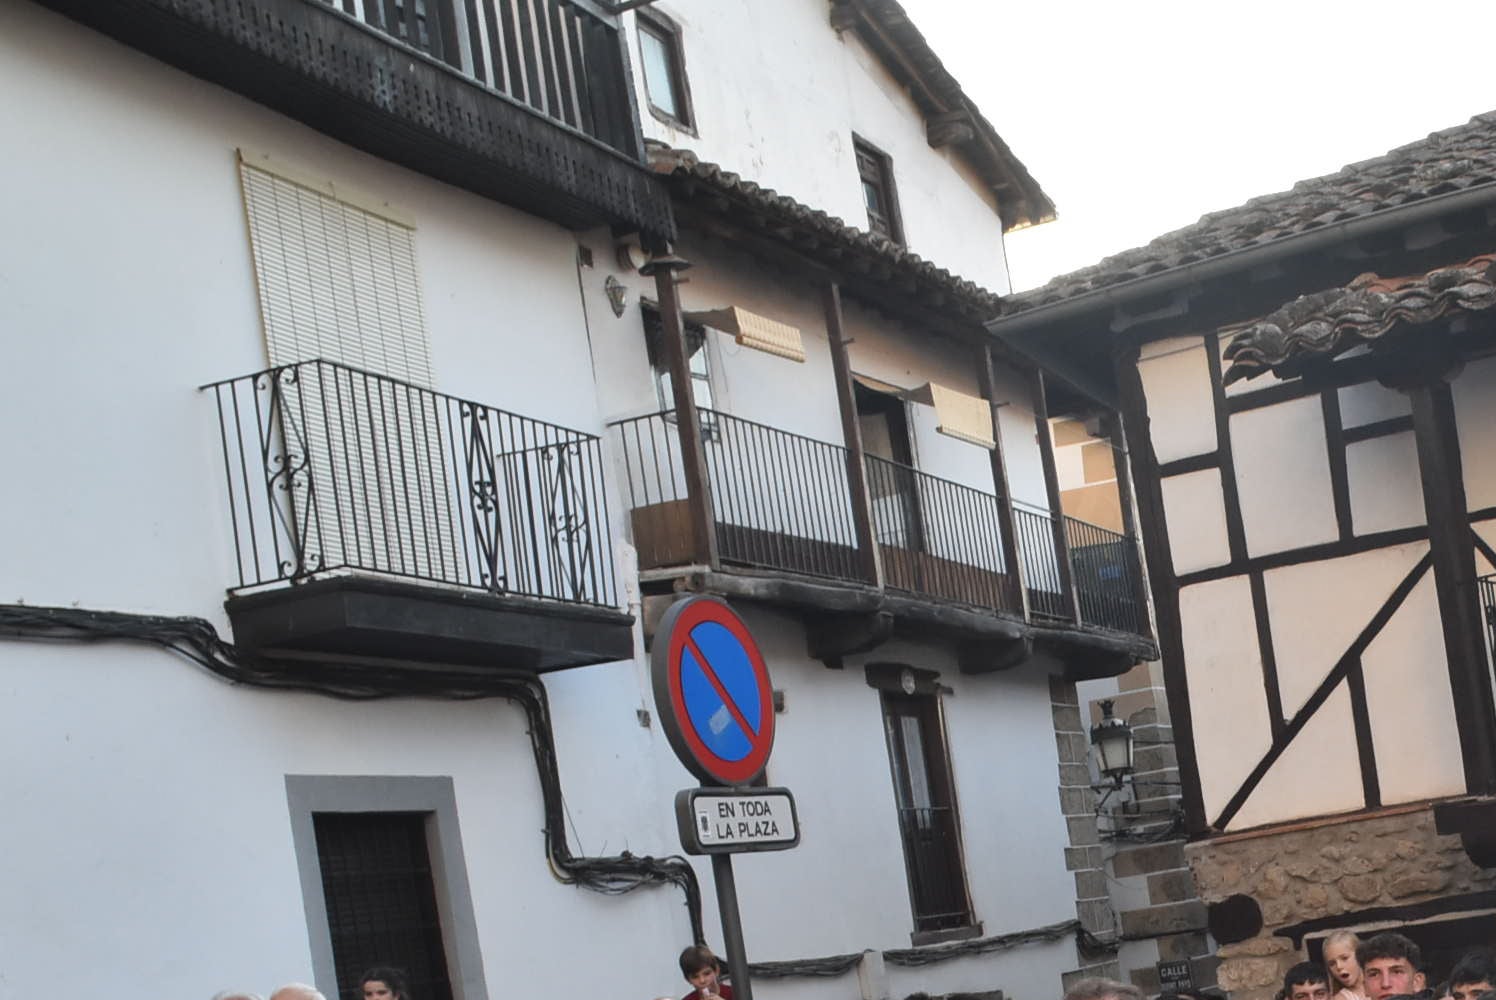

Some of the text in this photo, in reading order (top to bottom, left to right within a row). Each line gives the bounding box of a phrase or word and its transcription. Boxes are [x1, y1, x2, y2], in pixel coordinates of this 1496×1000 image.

[718, 801, 772, 818] EN TODA
[717, 823, 734, 839] LA
[739, 821, 779, 838] PLAZA
[1160, 964, 1188, 977] CALLE
